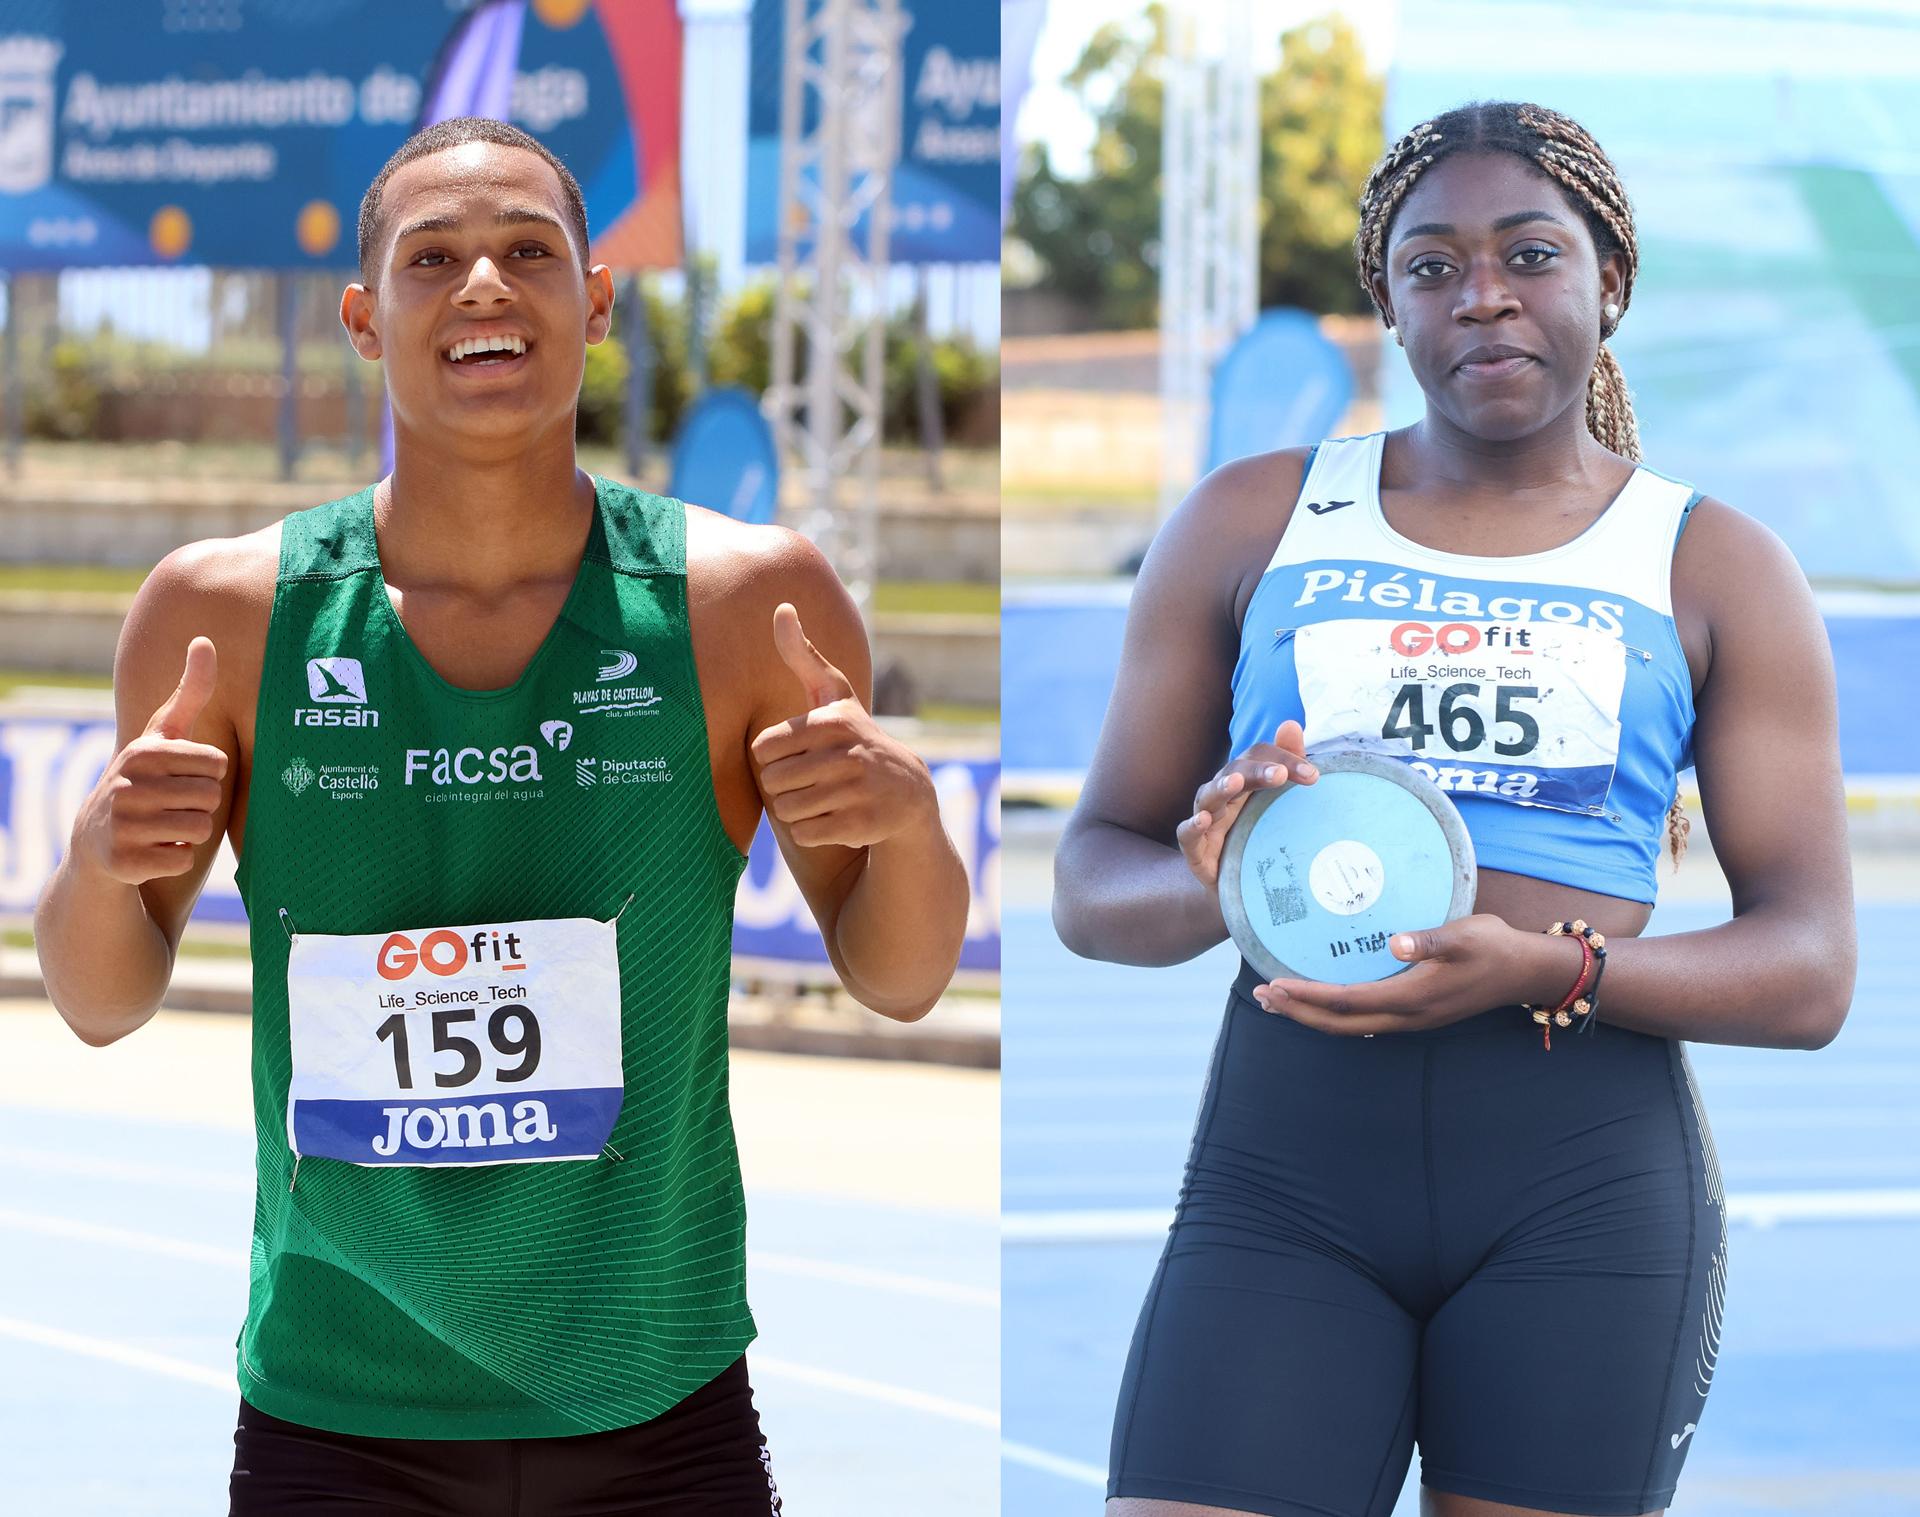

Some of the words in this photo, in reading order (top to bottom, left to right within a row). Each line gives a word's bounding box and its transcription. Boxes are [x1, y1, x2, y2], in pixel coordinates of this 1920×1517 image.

[573, 689, 600, 704] PLAYAS
[601, 688, 612, 701] DE
[294, 706, 379, 727] rasán
[605, 710, 622, 718] club
[1381, 683, 1540, 757] 465
[319, 765, 366, 775] Ajuntament
[368, 765, 379, 774] de
[602, 757, 667, 773] Diputació
[319, 774, 379, 790] Castelló
[602, 773, 620, 784] de
[621, 770, 673, 784] Castelló
[1408, 762, 1540, 798] oma
[332, 791, 363, 801] Esports
[494, 789, 509, 800] del
[513, 789, 545, 801] agua
[375, 1003, 542, 1090] 159
